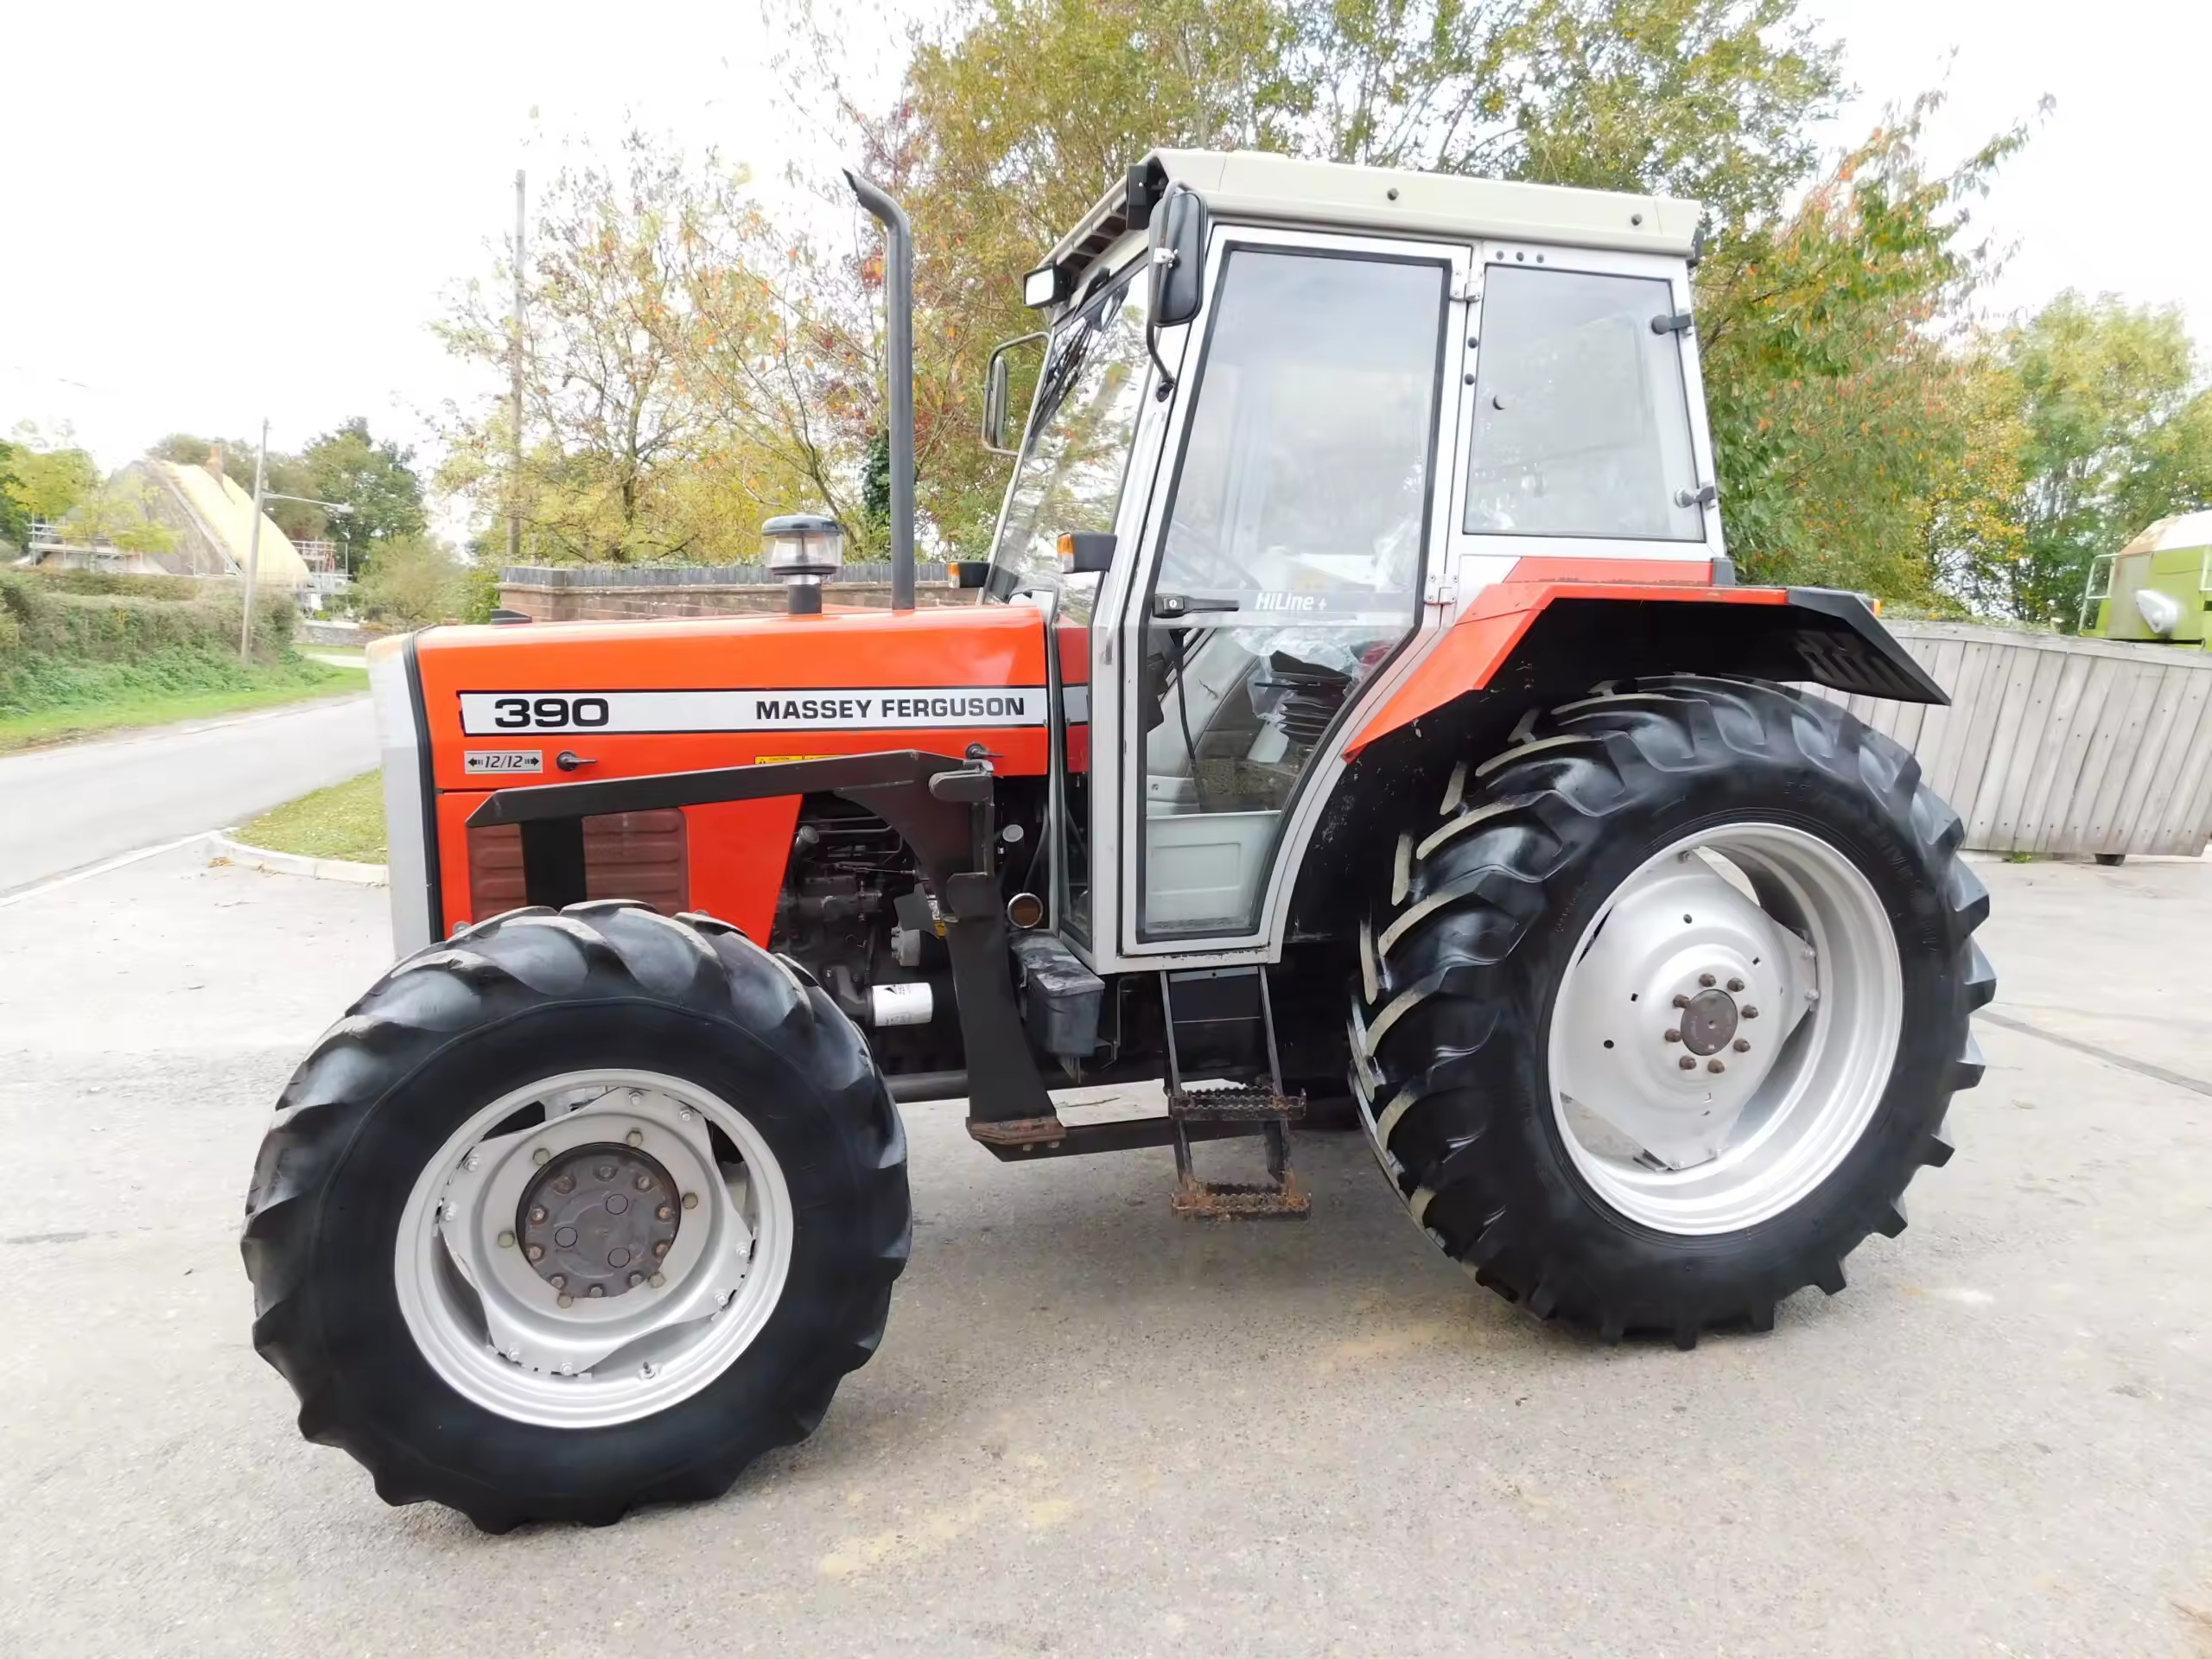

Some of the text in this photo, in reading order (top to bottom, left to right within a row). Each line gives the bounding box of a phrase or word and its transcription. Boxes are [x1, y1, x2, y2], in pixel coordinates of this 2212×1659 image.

[494, 698, 609, 728] 390
[756, 697, 1025, 720] MASSEY FERGUSON
[485, 754, 524, 768] 12/12
